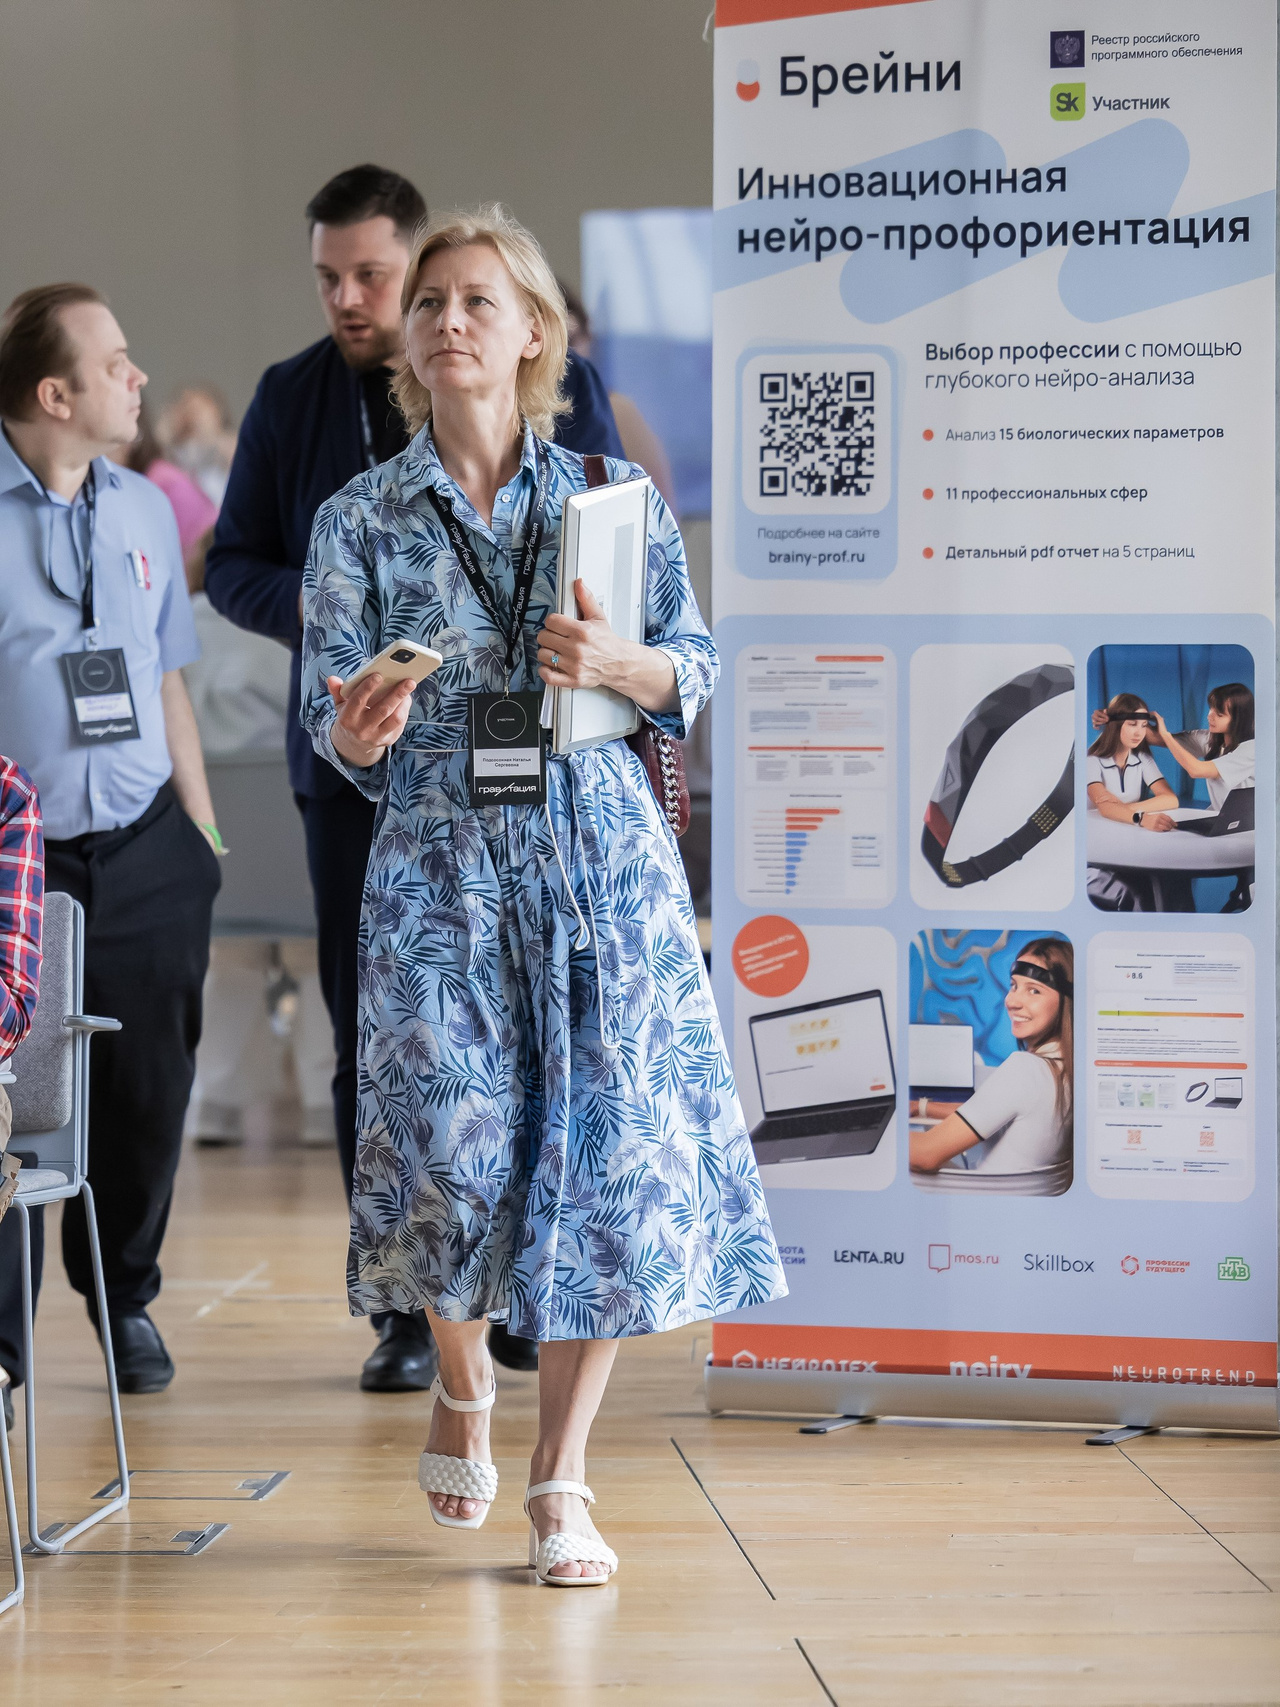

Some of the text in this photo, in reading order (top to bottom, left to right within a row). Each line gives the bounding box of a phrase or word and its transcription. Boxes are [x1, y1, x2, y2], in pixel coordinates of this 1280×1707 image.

[1091, 31, 1200, 47] Реестр российского
[1091, 45, 1243, 62] программного обеспечения
[780, 51, 963, 108] Брейни
[1056, 92, 1079, 114] Sk
[1092, 95, 1171, 112] Участник
[737, 166, 1067, 201] Инновационная
[737, 215, 1251, 262] нейро-профориентация
[925, 341, 1242, 365] Выбор профессии с помощью
[925, 368, 1195, 393] глубокого нейро-анализа
[945, 426, 1224, 442] Анализ 15 биологических параметров
[945, 485, 1148, 504] 11 профессиональных сфер
[757, 526, 880, 541] Подробнее на сайте
[768, 549, 865, 566] brainy-prof.ru
[945, 545, 1195, 561] Детальный pdf отчет на 5 страниц
[778, 1246, 805, 1254] БОТА
[834, 1250, 905, 1265] LENTA.RU
[954, 1254, 999, 1264] mos.ru
[1024, 1253, 1095, 1273] Skillbox
[1145, 1259, 1190, 1267] ПРОФЕССИИ
[1221, 1260, 1247, 1278] НТВ
[1113, 1365, 1255, 1383] NEUROTREND
